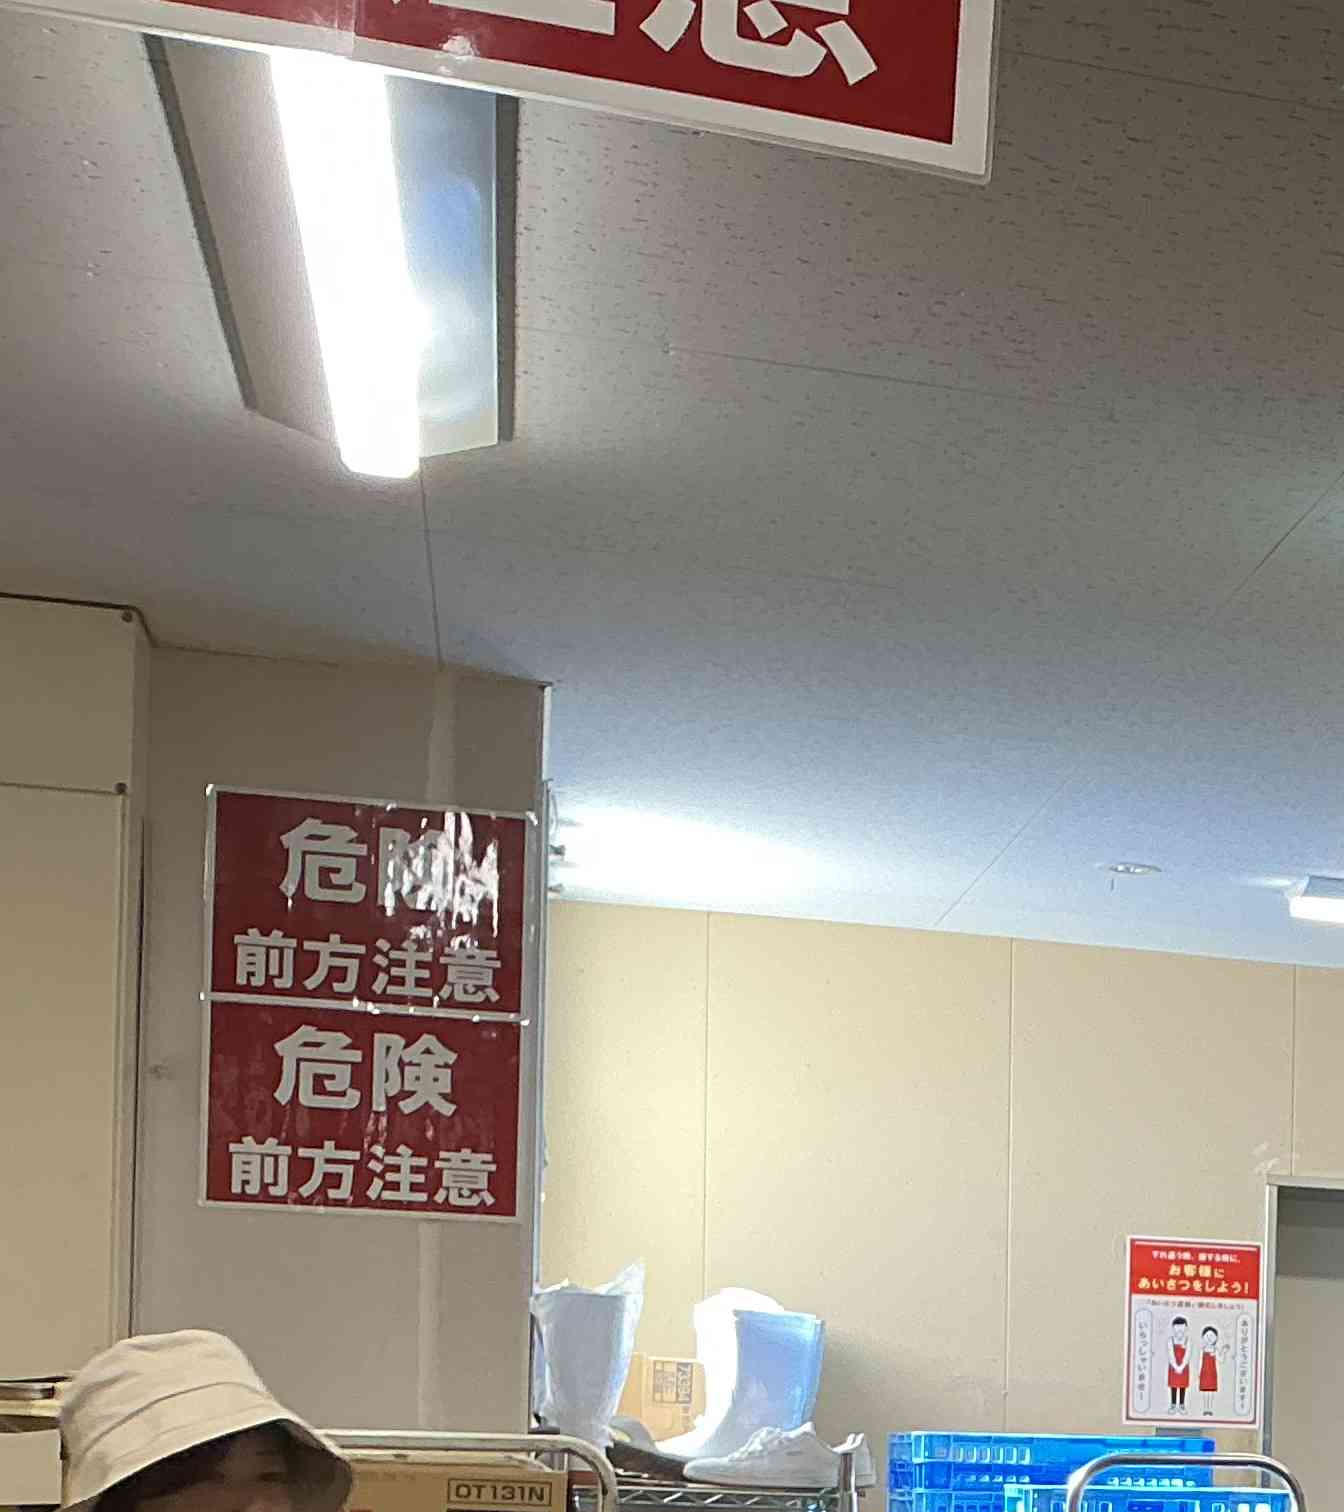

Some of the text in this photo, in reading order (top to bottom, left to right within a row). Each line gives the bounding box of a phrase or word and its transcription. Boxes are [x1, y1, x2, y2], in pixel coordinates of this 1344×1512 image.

[234, 929, 501, 1002] 前方注意
[274, 1025, 458, 1117] 危険
[229, 1136, 496, 1207] 前方注意
